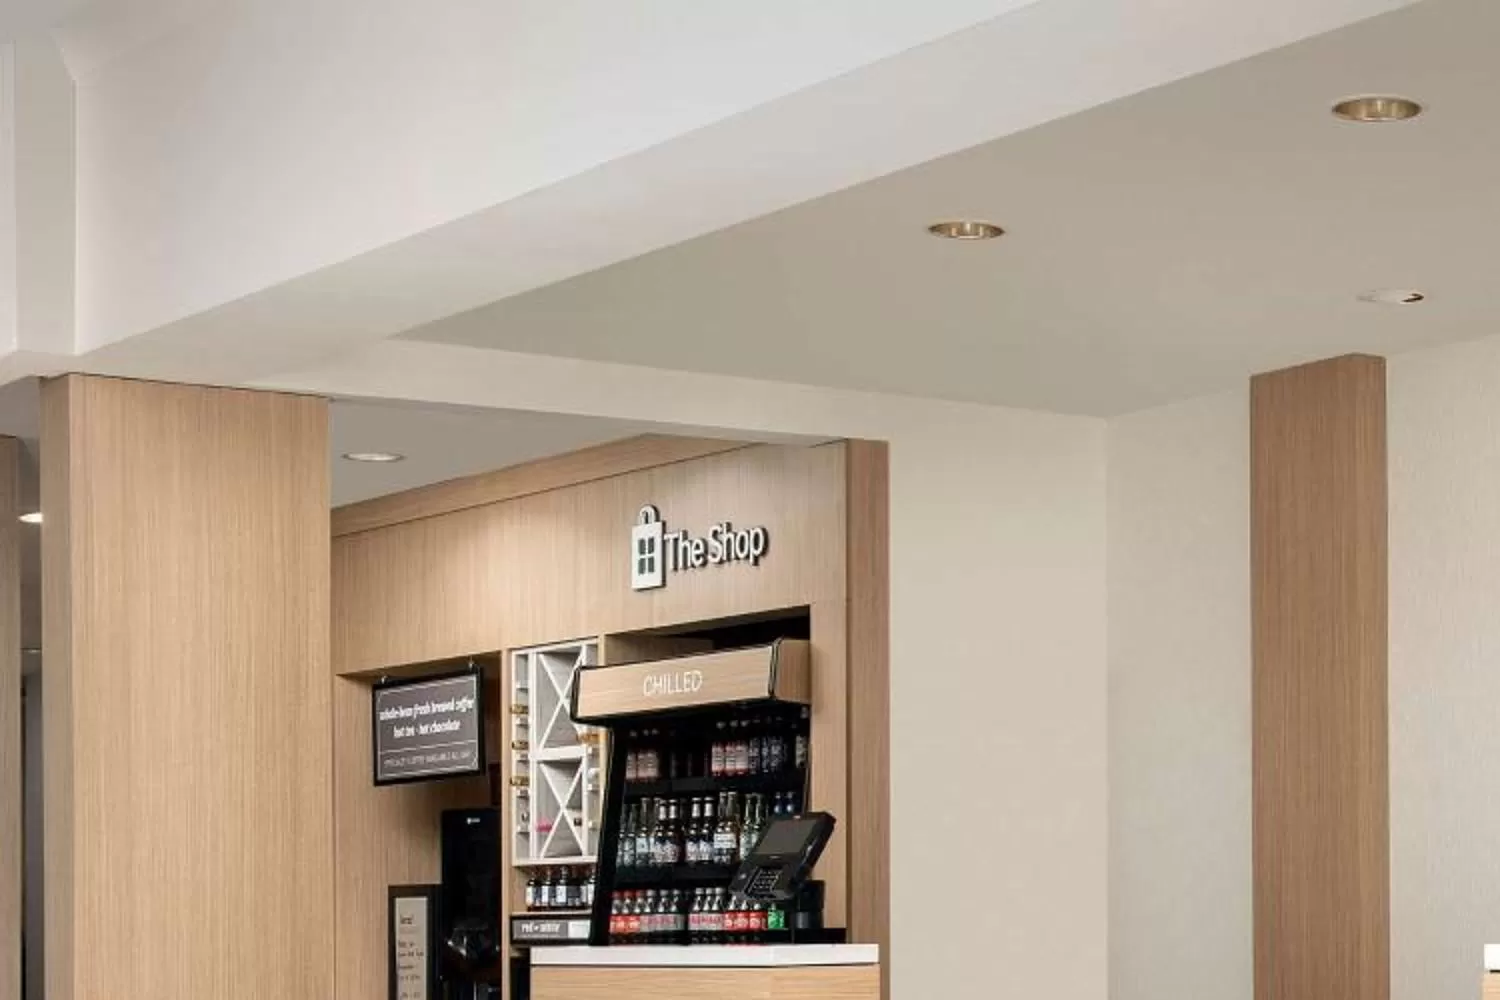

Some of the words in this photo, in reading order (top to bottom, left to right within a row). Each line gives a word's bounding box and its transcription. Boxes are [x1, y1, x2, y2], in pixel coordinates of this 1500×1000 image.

[663, 529, 706, 571] The
[707, 521, 767, 565] Shop
[643, 669, 703, 696] CHILLED
